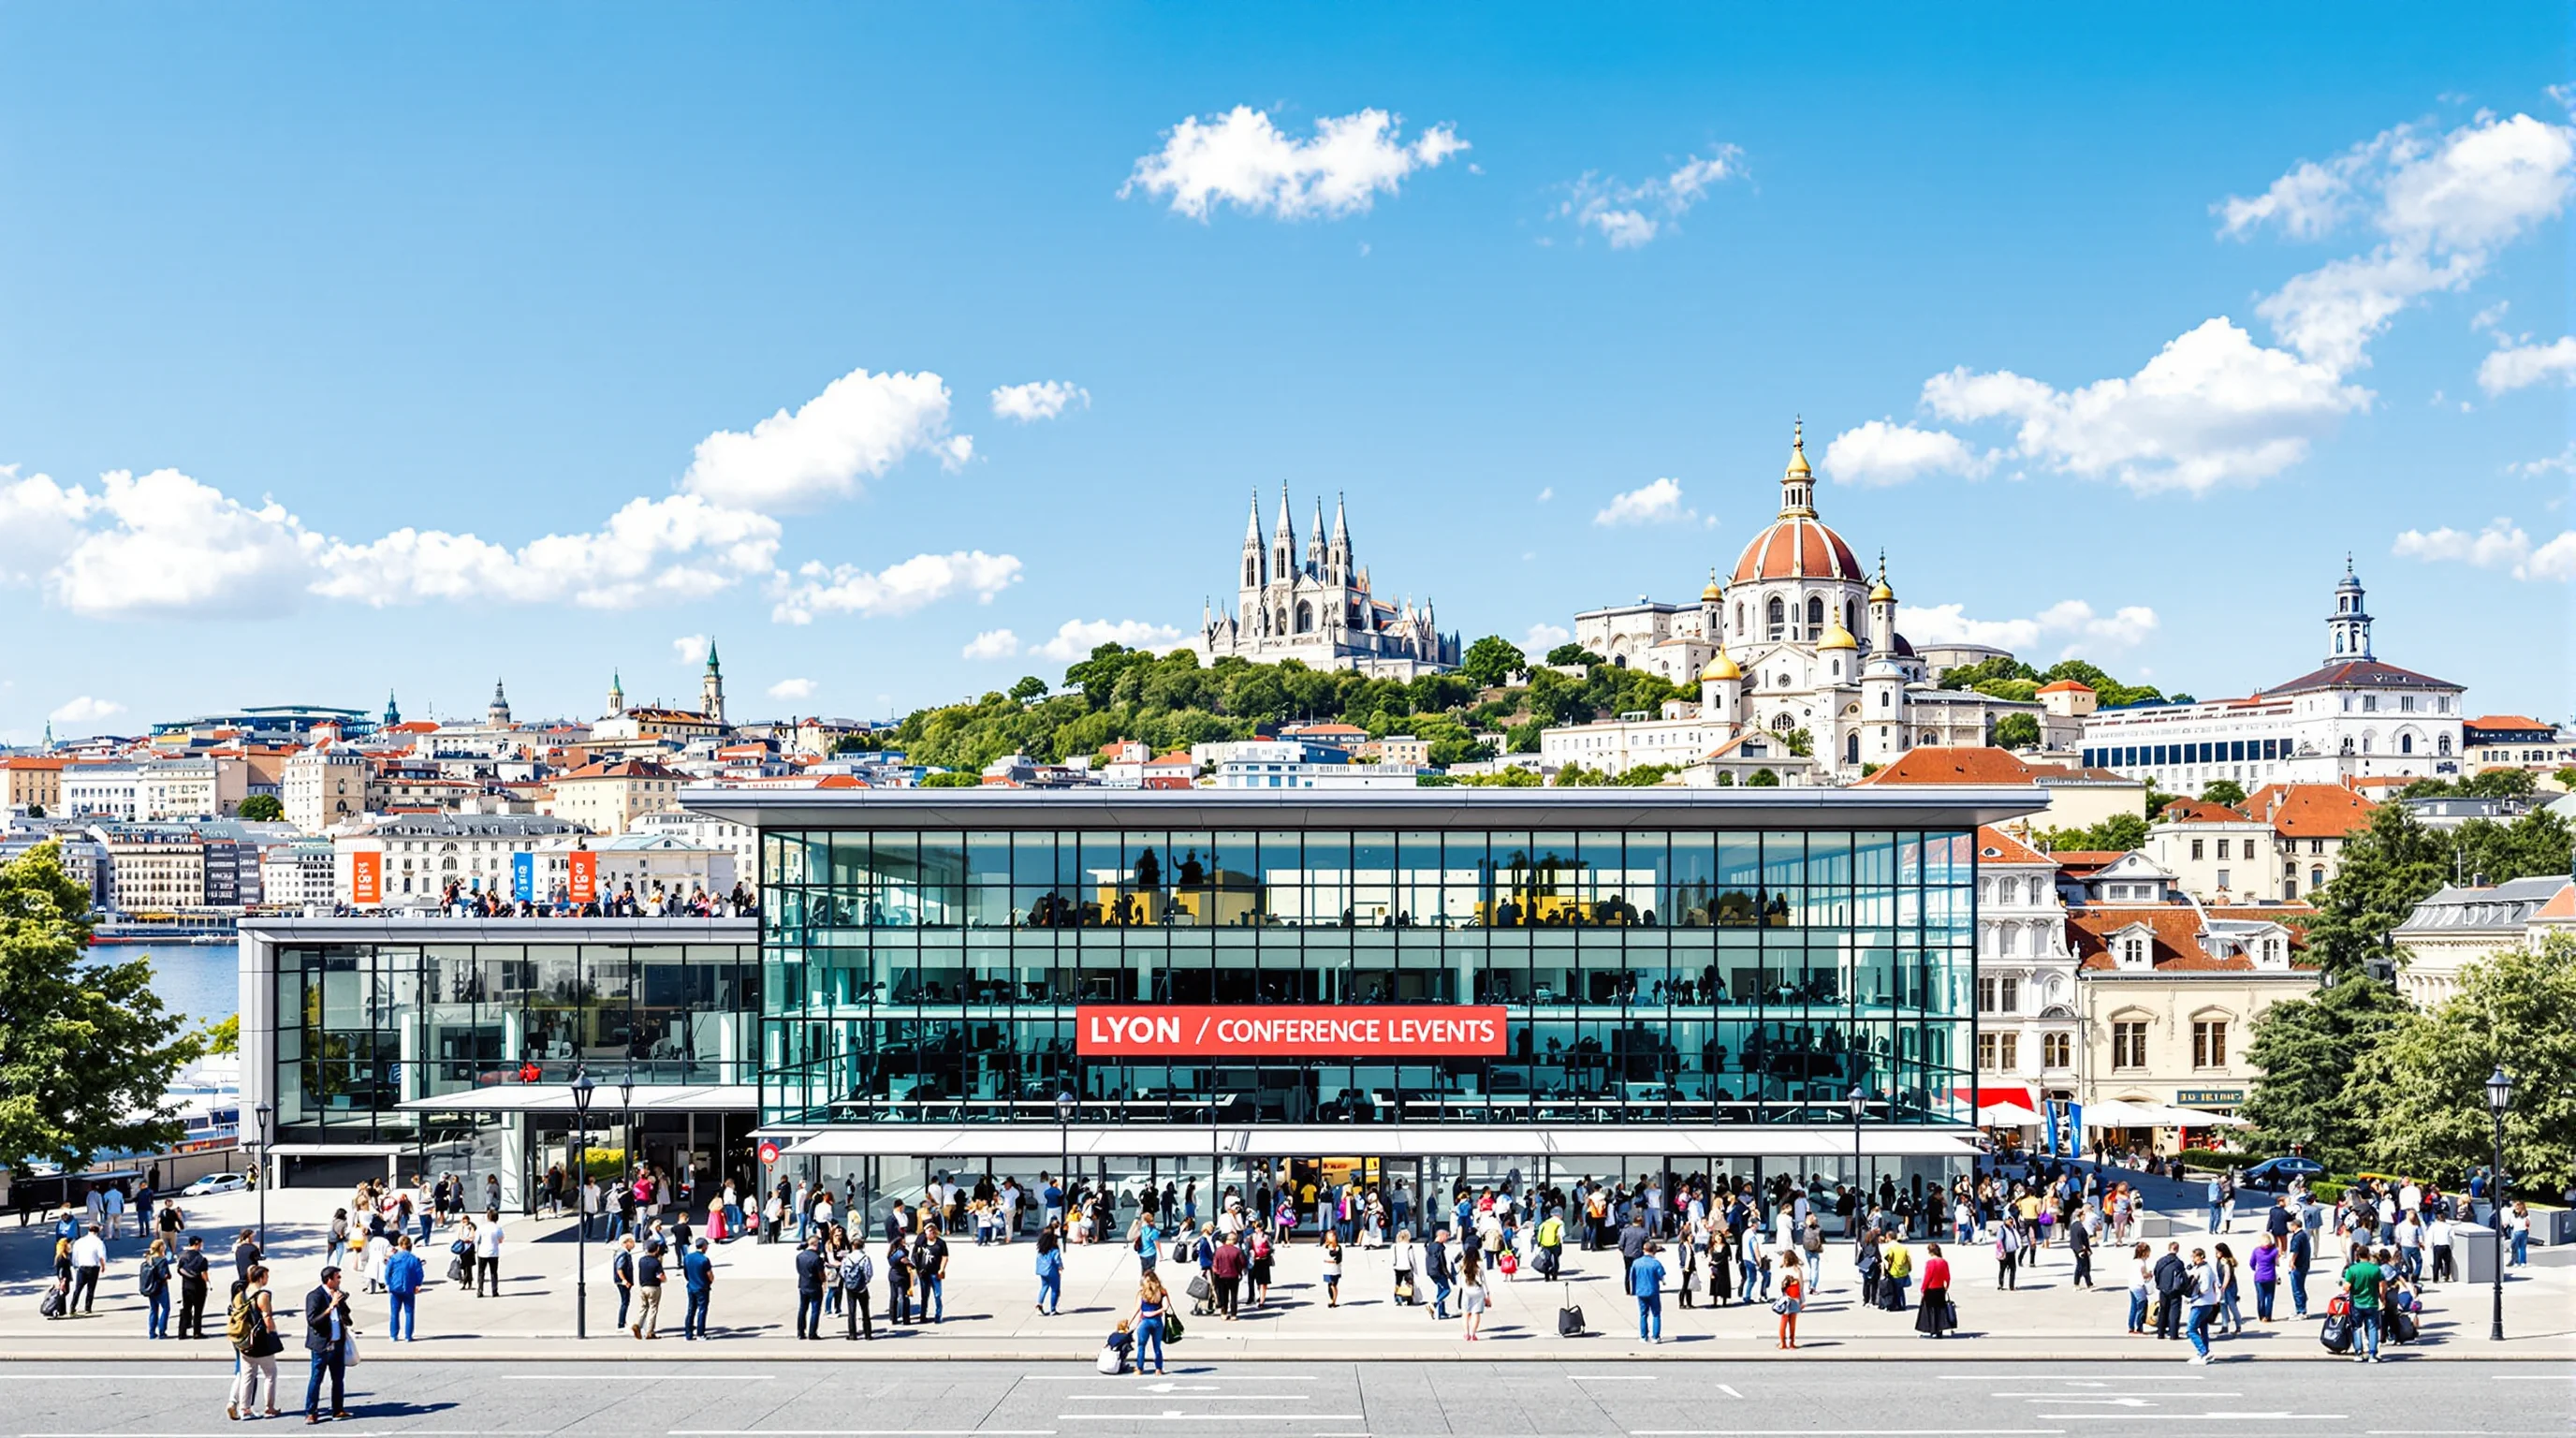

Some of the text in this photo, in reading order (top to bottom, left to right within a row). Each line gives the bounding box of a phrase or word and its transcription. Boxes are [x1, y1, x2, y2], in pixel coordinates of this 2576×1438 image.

[1090, 1016, 1180, 1043] LYON
[1217, 1019, 1381, 1043] CONFERENCE
[1387, 1019, 1495, 1043] LEVENTS
